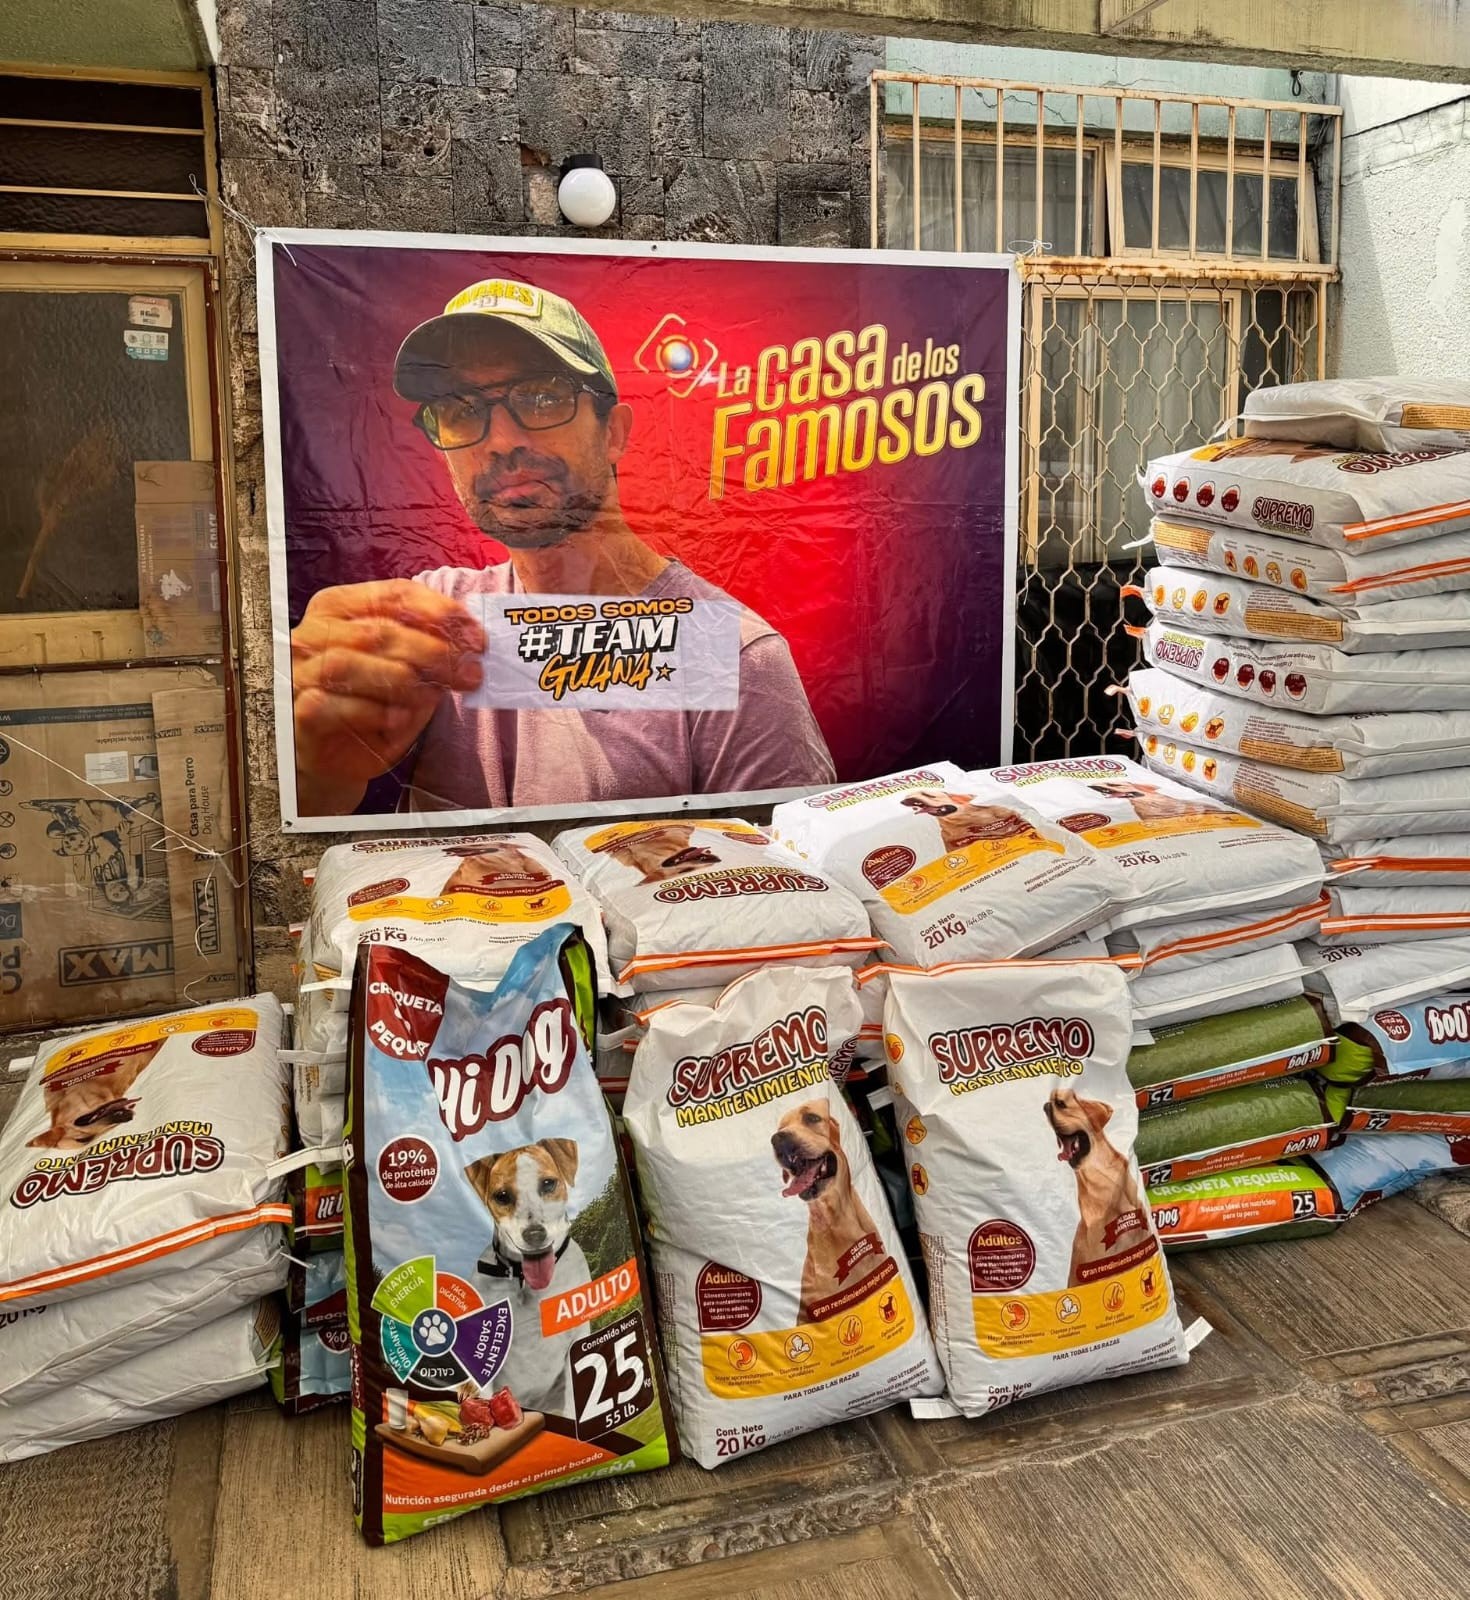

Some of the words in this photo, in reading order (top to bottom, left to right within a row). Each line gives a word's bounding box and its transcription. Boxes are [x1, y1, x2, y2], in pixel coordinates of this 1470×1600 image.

[716, 361, 751, 399] La
[708, 373, 986, 501] Famosos
[1252, 496, 1314, 531] SUPREMO
[504, 603, 596, 625] TODOS
[600, 598, 693, 619] SOMOS
[518, 614, 679, 662] #TEAM
[1156, 639, 1204, 670] SUPREMO
[538, 651, 654, 701] GUANA
[185, 757, 195, 787] Perro
[990, 759, 1127, 783] SUPREMO
[187, 788, 201, 810] para
[201, 785, 209, 811] House
[804, 770, 945, 809] SUPREMO
[189, 810, 200, 838] Casa
[202, 812, 213, 835] Dog
[1118, 857, 1140, 868] 20
[1139, 853, 1161, 866] Kg
[653, 872, 830, 905] SUPREMO
[358, 932, 381, 945] 20
[384, 930, 408, 942] Kg
[919, 922, 939, 937] Cont.
[938, 913, 957, 926] Neto
[923, 928, 946, 950] 20
[945, 919, 967, 939] Kg
[1322, 951, 1343, 963] 20
[1342, 945, 1363, 957] Kg
[1387, 1024, 1408, 1036] 10%
[1427, 1005, 1469, 1042] Dog
[667, 1005, 829, 1107] SUPREMO
[928, 1016, 1095, 1084] SUPREMO
[1286, 1051, 1308, 1071] Dog
[1307, 1046, 1322, 1063] Hi
[433, 1061, 482, 1134] Hi
[490, 1006, 570, 1115] Dog
[676, 1059, 830, 1128] MANTENIMIENTO
[1150, 1085, 1173, 1103] 25
[1366, 1117, 1389, 1130] 25
[1283, 1137, 1305, 1155] Dog
[1305, 1133, 1320, 1151] Hi
[388, 1148, 427, 1167] 19%
[10, 1132, 225, 1210] SUPREMO
[382, 1170, 393, 1180] de
[394, 1180, 407, 1188] alta
[407, 1177, 433, 1187] calidad
[1149, 1167, 1172, 1186] 25
[1152, 1177, 1231, 1197] CROQUETA
[1232, 1169, 1302, 1188] PEQUEÑA
[317, 1197, 335, 1219] Hi
[1222, 1212, 1236, 1222] para
[1244, 1210, 1260, 1220] perro
[1293, 1194, 1315, 1214] 25
[1157, 1206, 1180, 1229] Dog
[977, 1235, 1023, 1247] Adultos
[705, 1271, 750, 1285] Adultos
[1081, 1266, 1099, 1278] gran
[1099, 1257, 1132, 1273] rendimiento
[384, 1265, 416, 1296] MAYOR
[812, 1304, 831, 1318] gran
[831, 1286, 868, 1311] rendimiento
[867, 1274, 881, 1290] mejor
[879, 1263, 894, 1279] precio
[556, 1268, 632, 1324] ADULTO
[386, 1318, 413, 1369] OXIDANTES
[472, 1319, 493, 1360] SABOR
[480, 1307, 508, 1378] EXCELENTE
[581, 1328, 620, 1353] Contenido
[1052, 1352, 1069, 1361] PARA
[1069, 1348, 1089, 1357] TODAS
[1089, 1344, 1101, 1352] LAS
[1101, 1338, 1120, 1350] RAZAS
[419, 1367, 456, 1378] CALCIO
[573, 1330, 645, 1425] 25
[783, 1390, 803, 1401] PARA
[803, 1383, 825, 1396] TODAS
[824, 1380, 838, 1391] LAS
[838, 1371, 860, 1386] RAZAS
[988, 1385, 1012, 1394] Cont.
[1012, 1382, 1032, 1392] Neto
[604, 1409, 622, 1429] 55
[623, 1403, 640, 1418] lb.
[716, 1427, 740, 1437] Cont.
[741, 1424, 763, 1434] Neto
[715, 1437, 740, 1457] 20
[384, 1492, 432, 1506] Nutrición
[432, 1486, 488, 1506] asegurada
[488, 1478, 521, 1494] desde
[521, 1474, 533, 1485] el
[532, 1463, 569, 1483] primer
[568, 1450, 605, 1469] bocado
